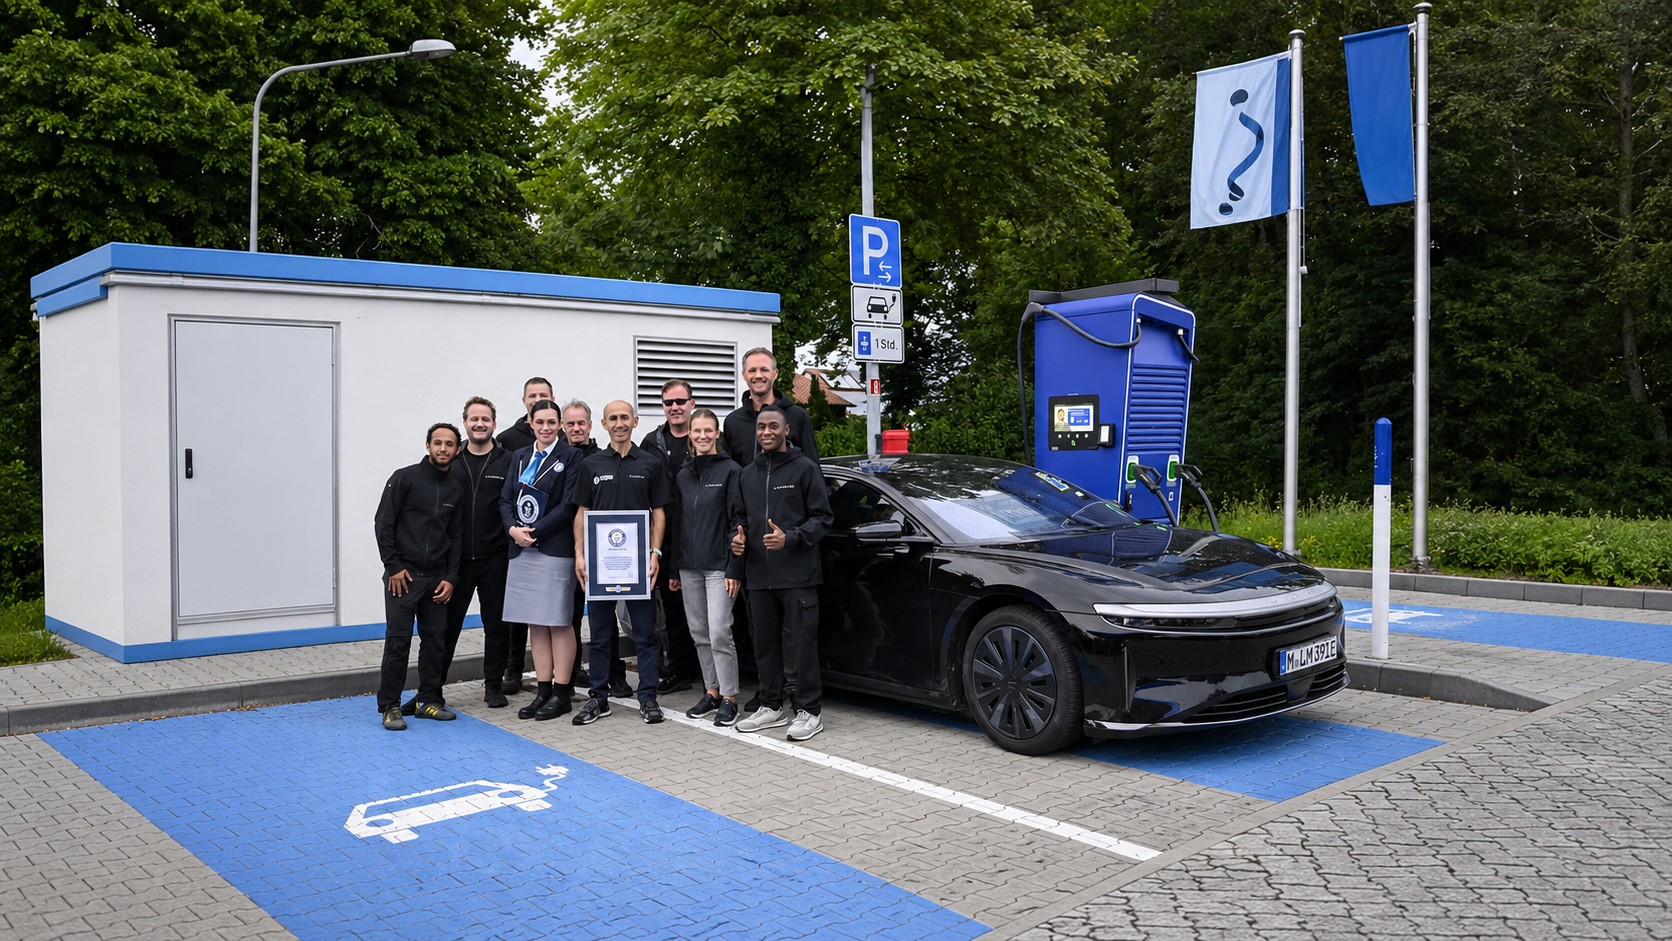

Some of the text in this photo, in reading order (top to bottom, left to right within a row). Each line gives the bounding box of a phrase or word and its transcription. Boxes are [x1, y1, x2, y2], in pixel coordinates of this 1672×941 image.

[863, 225, 889, 276] P
[881, 339, 898, 350] Std.
[1287, 651, 1295, 671] M
